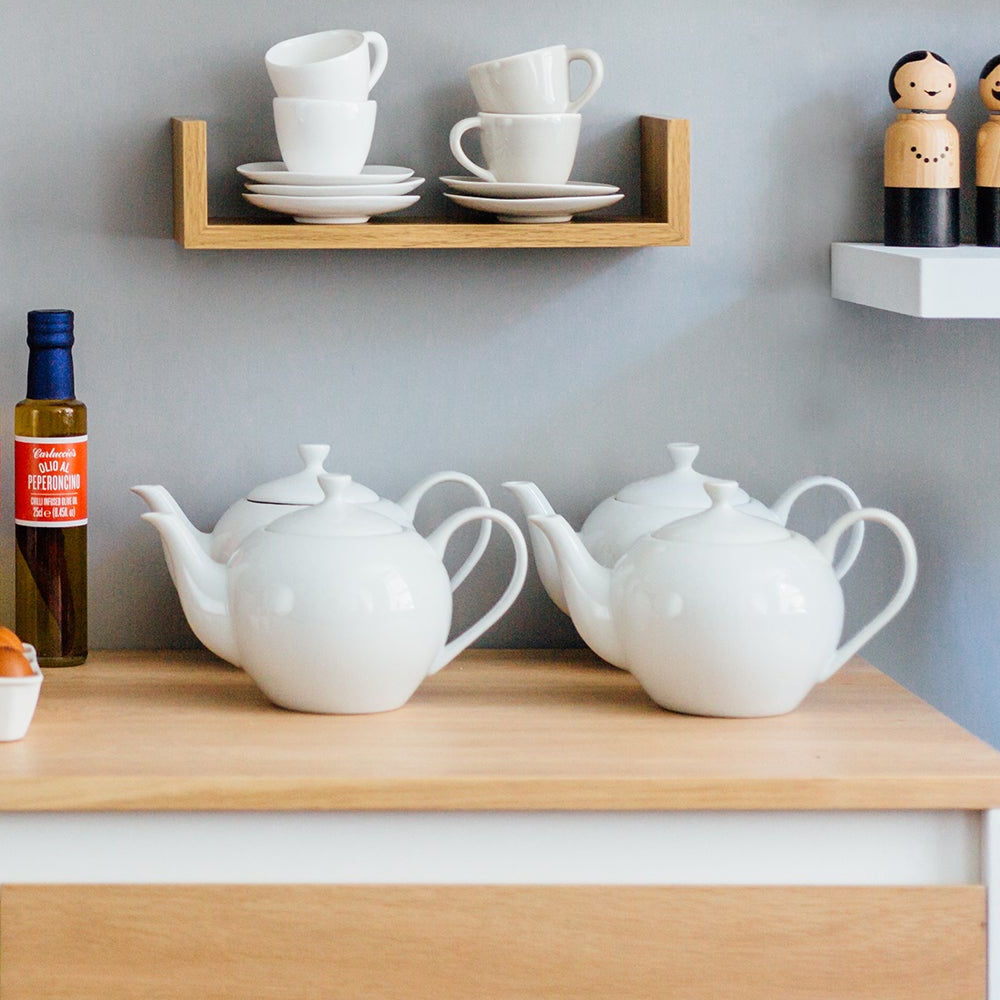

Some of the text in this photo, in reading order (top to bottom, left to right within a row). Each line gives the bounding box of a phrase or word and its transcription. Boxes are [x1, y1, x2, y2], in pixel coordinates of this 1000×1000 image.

[32, 447, 76, 458] Carluccio's
[38, 460, 70, 473] OLIO AL
[28, 474, 80, 490] PEPERONCINO
